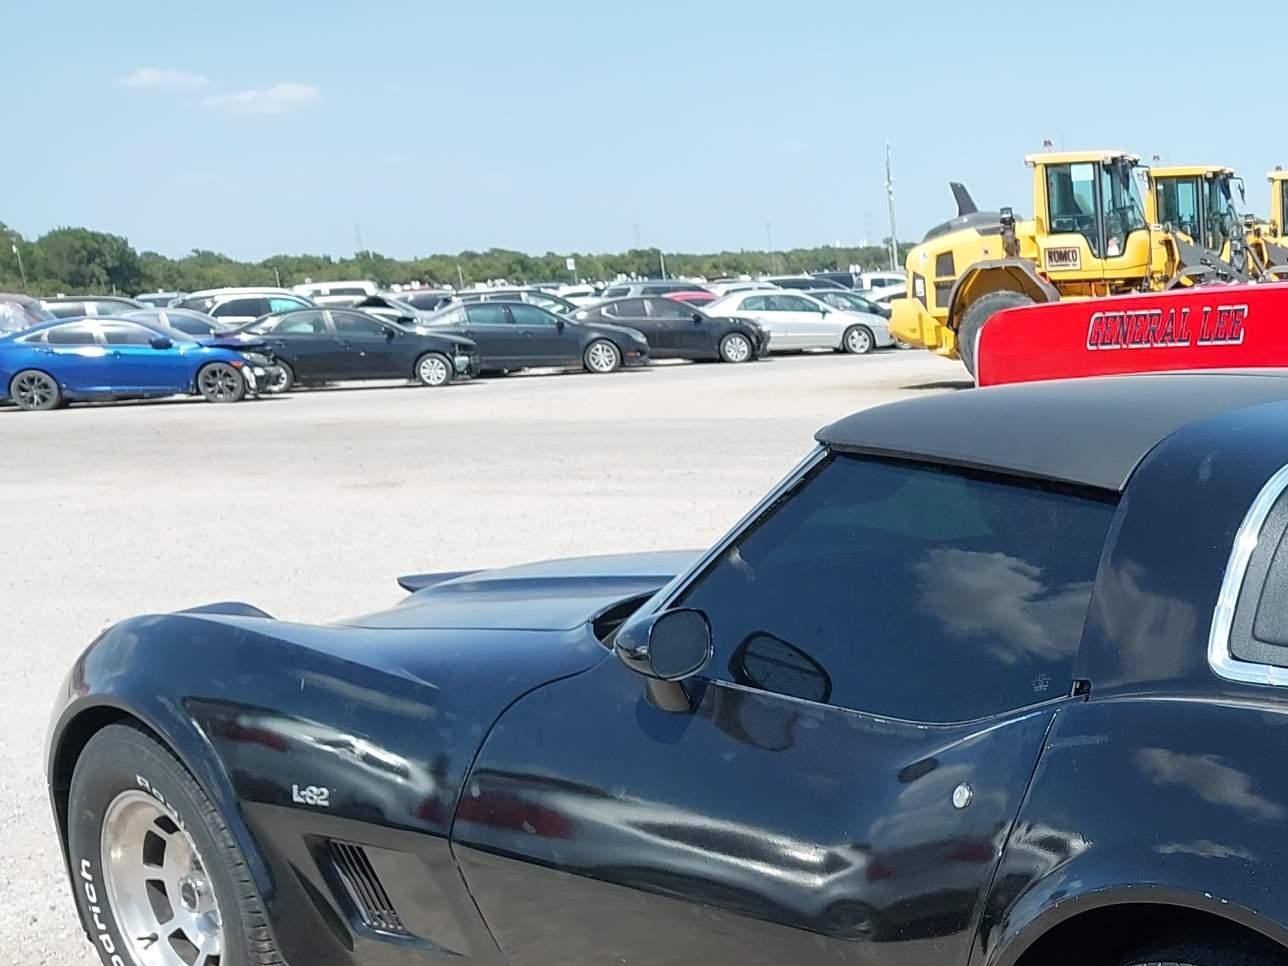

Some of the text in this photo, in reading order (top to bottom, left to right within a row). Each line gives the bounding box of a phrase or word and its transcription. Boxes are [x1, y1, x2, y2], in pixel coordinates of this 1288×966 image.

[1047, 249, 1078, 263] ROMCO
[1088, 304, 1248, 350] GENERAL LEE
[292, 784, 330, 807] L-82
